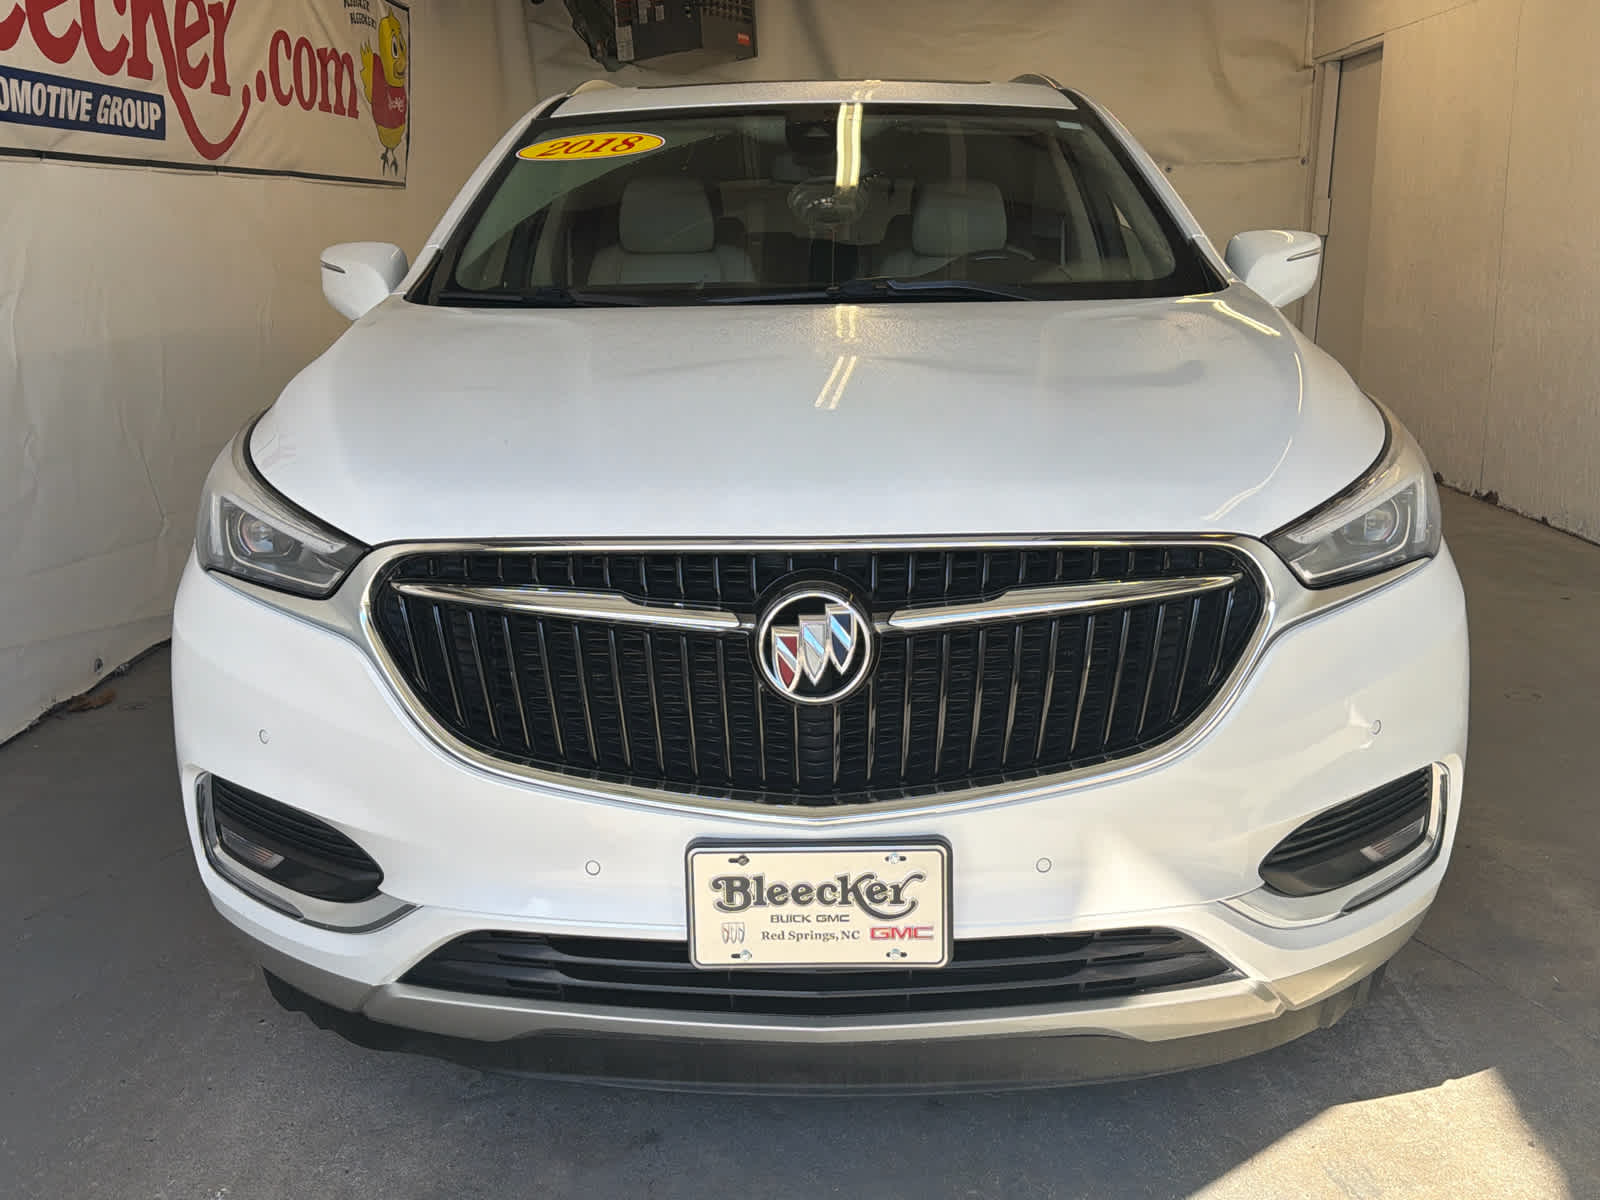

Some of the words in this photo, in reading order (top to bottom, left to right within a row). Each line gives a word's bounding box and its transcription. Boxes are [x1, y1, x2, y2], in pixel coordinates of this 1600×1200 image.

[96, 94, 161, 131] GROUP
[536, 135, 644, 157] 2018
[770, 914, 812, 923] BUICK
[816, 914, 850, 922] GMC
[761, 931, 785, 940] Red
[788, 930, 839, 942] Springs,
[841, 930, 860, 940] NC
[870, 926, 934, 940] GMC
